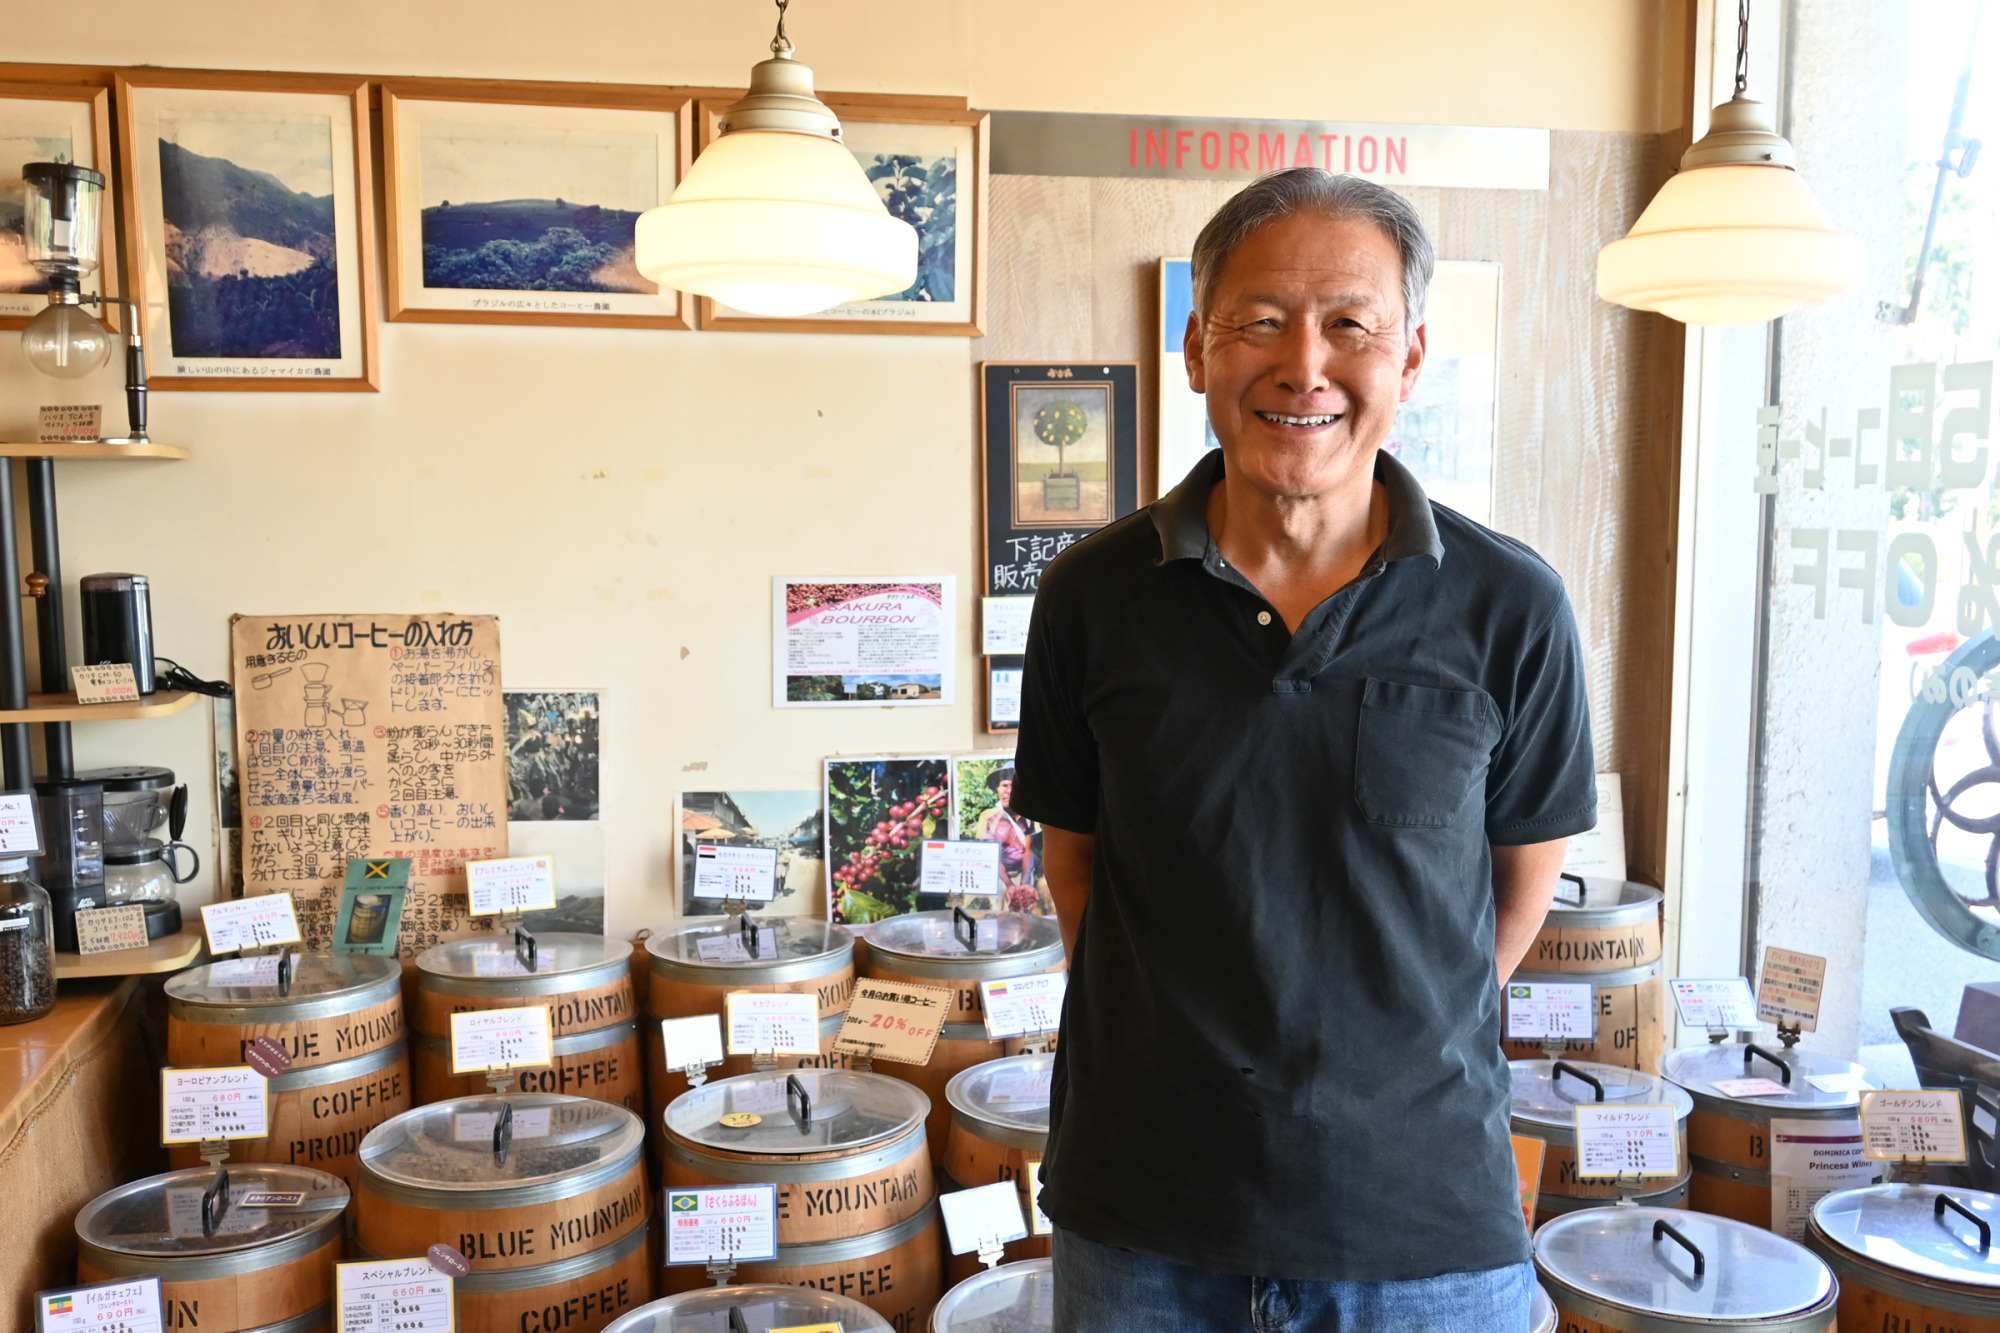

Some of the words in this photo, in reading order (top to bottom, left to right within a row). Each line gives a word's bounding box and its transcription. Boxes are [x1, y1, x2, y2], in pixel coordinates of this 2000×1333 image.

[1129, 128, 1407, 175] INFORMATION
[826, 602, 903, 612] SAKURA
[820, 614, 917, 625] BOURBON
[265, 620, 474, 651] おいしいコーヒーの入れ方
[250, 865, 348, 881] 分けて注湯しま
[1539, 937, 1645, 962] MOUNTAIN
[469, 1014, 524, 1027] ロイヤルブレンド
[908, 1026, 934, 1039] OFF
[1614, 1026, 1637, 1050] OF
[258, 1038, 290, 1065] ESPRESSO
[177, 1074, 249, 1086] ヨーロピアンブレンド
[519, 1058, 619, 1094] COFFEE
[212, 1092, 241, 1102] 680円
[312, 1073, 402, 1120] COFFEE
[1880, 1098, 1942, 1109] ゴールデンブレンド
[1595, 1112, 1651, 1121] マイルドブレンド
[1626, 1129, 1653, 1138] 570円
[1813, 1149, 1851, 1157] DOMINICA
[1809, 1161, 1849, 1171] Princesa
[805, 1168, 919, 1217] MOUNTAIN
[460, 1228, 535, 1260] BLUE
[550, 1185, 642, 1250] MOUNTAIN
[721, 1215, 751, 1225] 680円
[431, 1245, 467, 1273] フレンチロースト
[362, 1265, 435, 1281] スペシャルブレンド
[780, 1264, 894, 1297] FFEE
[86, 1284, 143, 1305] 『イルガチェフェ』
[392, 1285, 424, 1298] 660円
[520, 1278, 630, 1333] COFFEE
[96, 1307, 133, 1321] 690円
